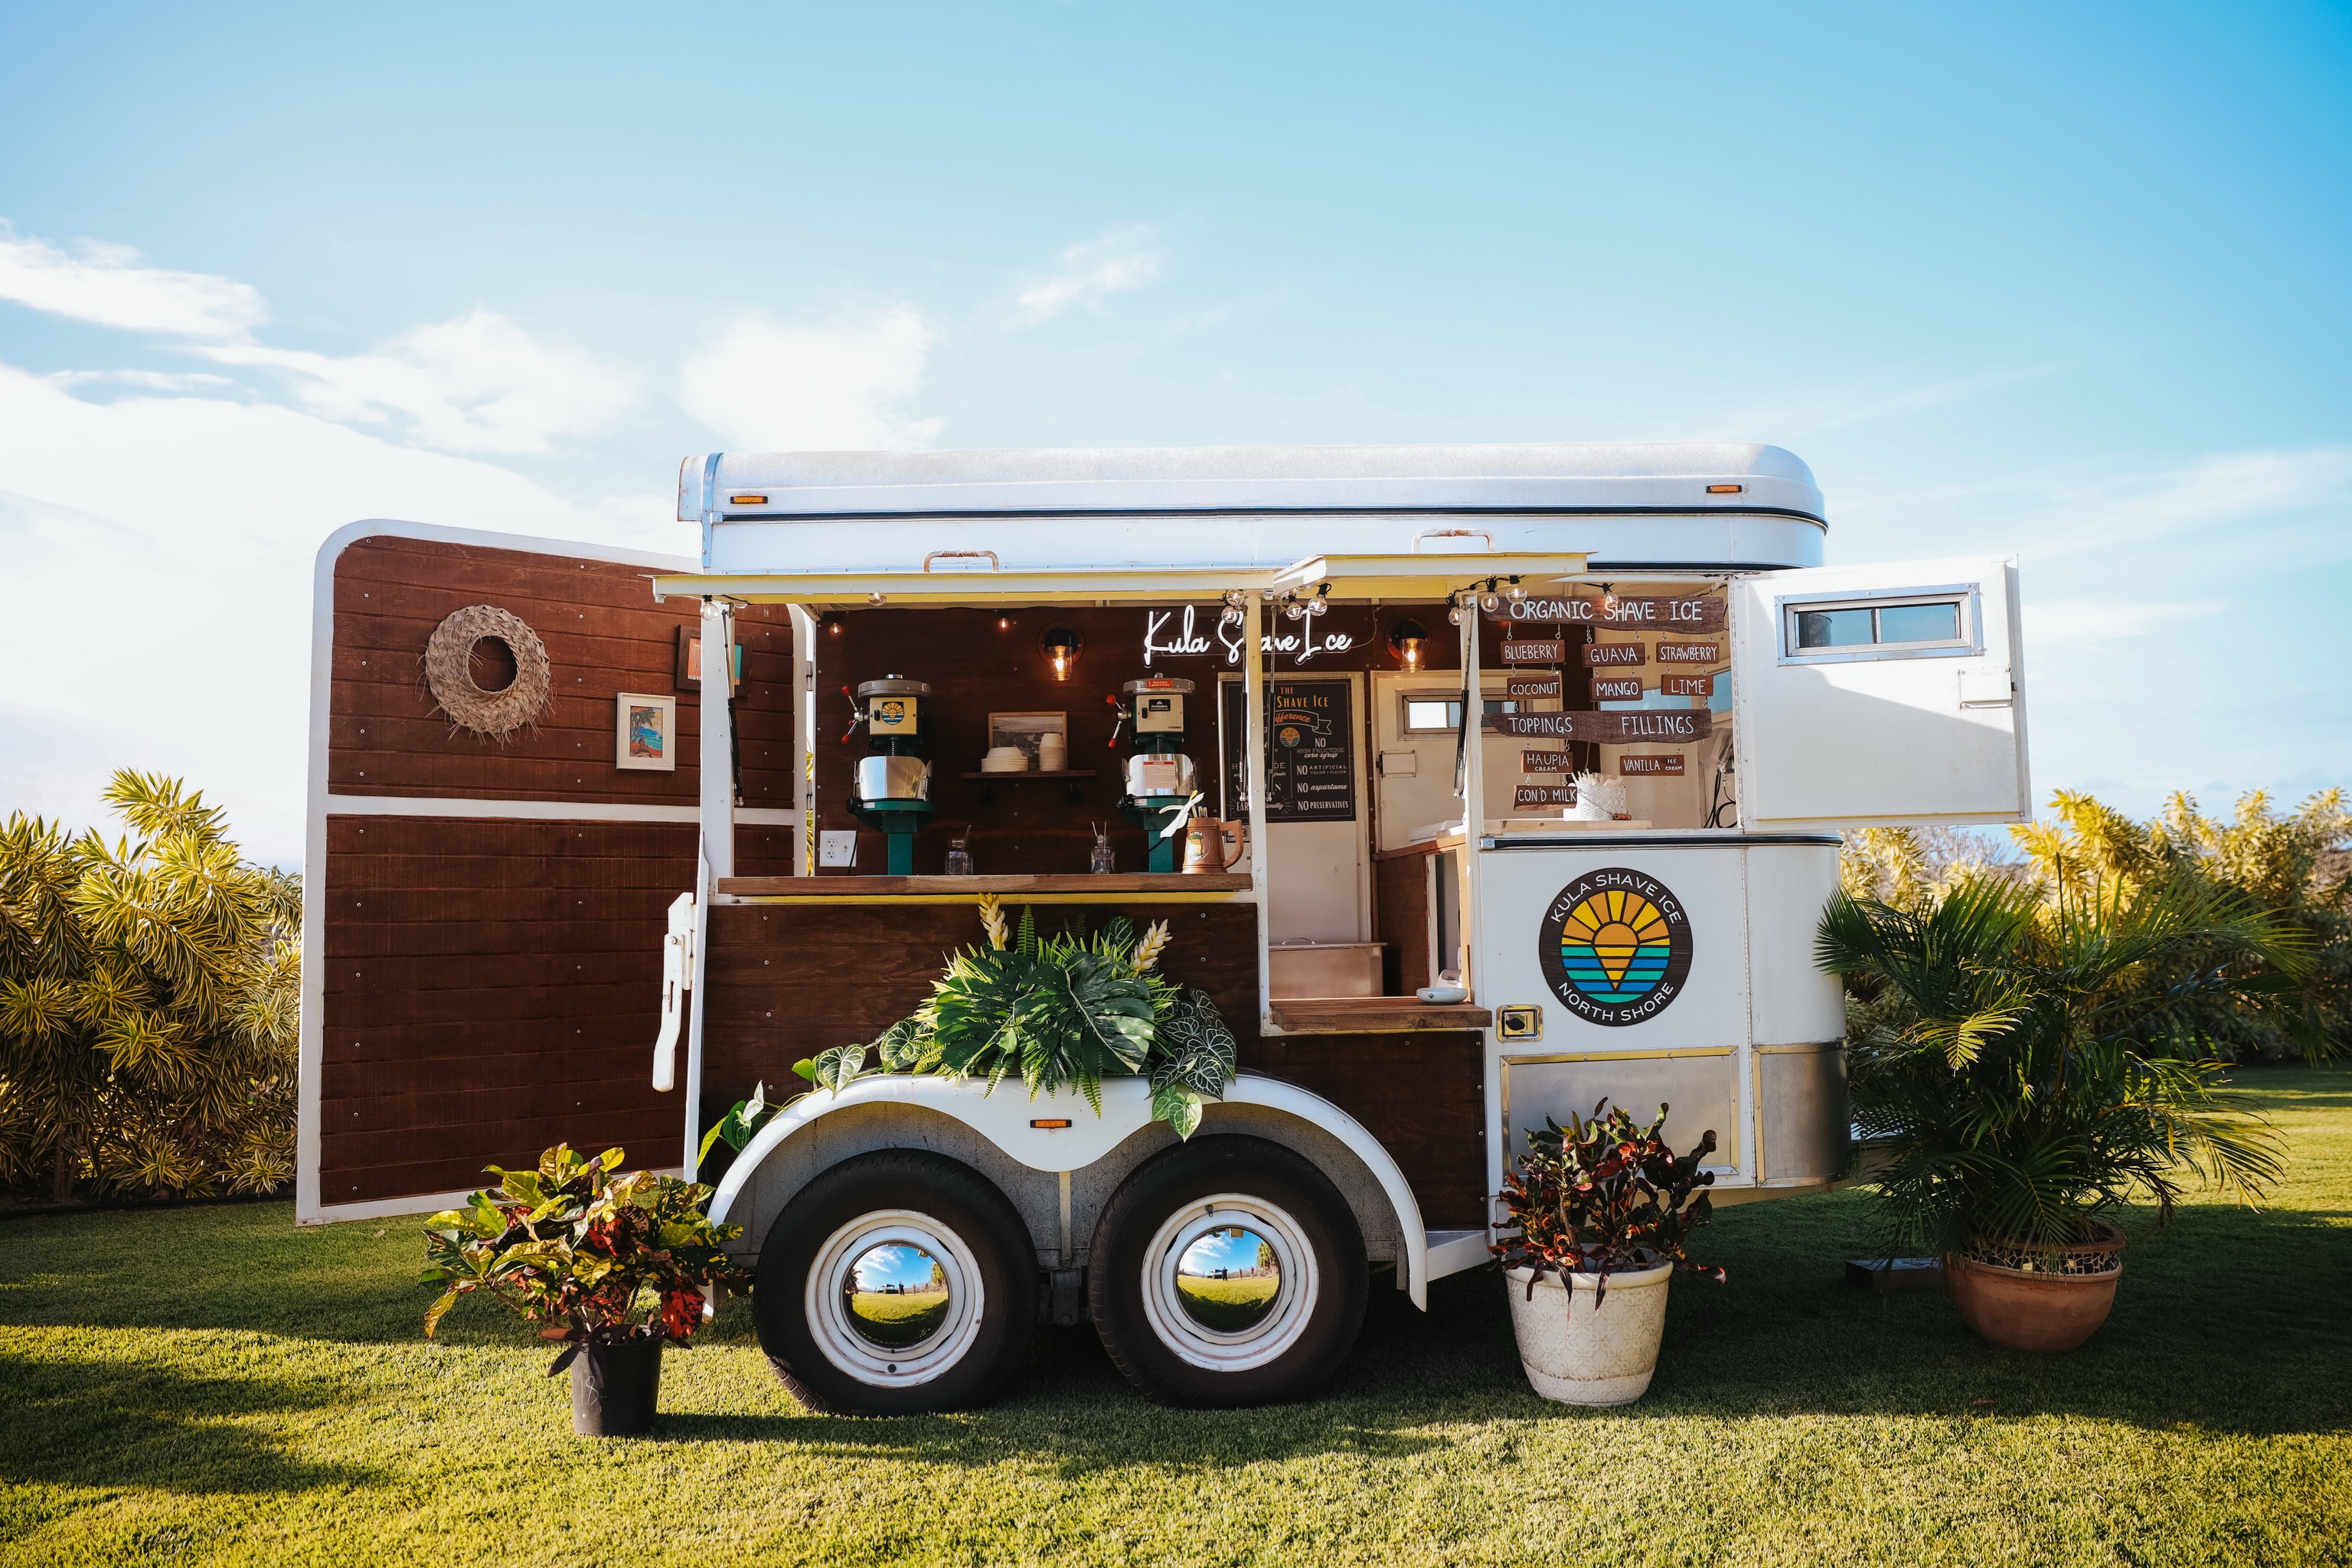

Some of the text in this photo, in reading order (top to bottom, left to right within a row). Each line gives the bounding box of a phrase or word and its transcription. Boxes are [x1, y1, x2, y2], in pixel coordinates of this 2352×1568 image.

[1509, 600, 1704, 622] ORGANIC SHAVE ICE
[1144, 604, 1353, 665] Kula Save Ice
[1504, 644, 1559, 660] BLUEBERRY
[1590, 646, 1638, 663] GUAVA
[1660, 645, 1717, 662] STRAWBERRY
[1511, 682, 1560, 695] COCONUT
[1596, 681, 1639, 696] MANGO
[1671, 679, 1707, 694] LIME
[1277, 695, 1308, 708] SHAVE
[1275, 712, 1312, 724] ifference
[1508, 717, 1573, 734] TOPPINGS
[1622, 715, 1694, 735] FILLINGS
[1315, 737, 1326, 748] NO
[1527, 753, 1569, 767] HAUPIA
[1623, 759, 1660, 772] VANILLA
[1296, 765, 1308, 775] NO
[1297, 782, 1348, 793] NO aspartame
[1517, 787, 1576, 802] CON'D MILK
[1236, 802, 1249, 812] EAR
[1298, 800, 1349, 811] NO PRESERVATIVES
[1550, 874, 1682, 924] KULA SHAVE ICE
[1558, 982, 1674, 1021] NORTH SHORE
